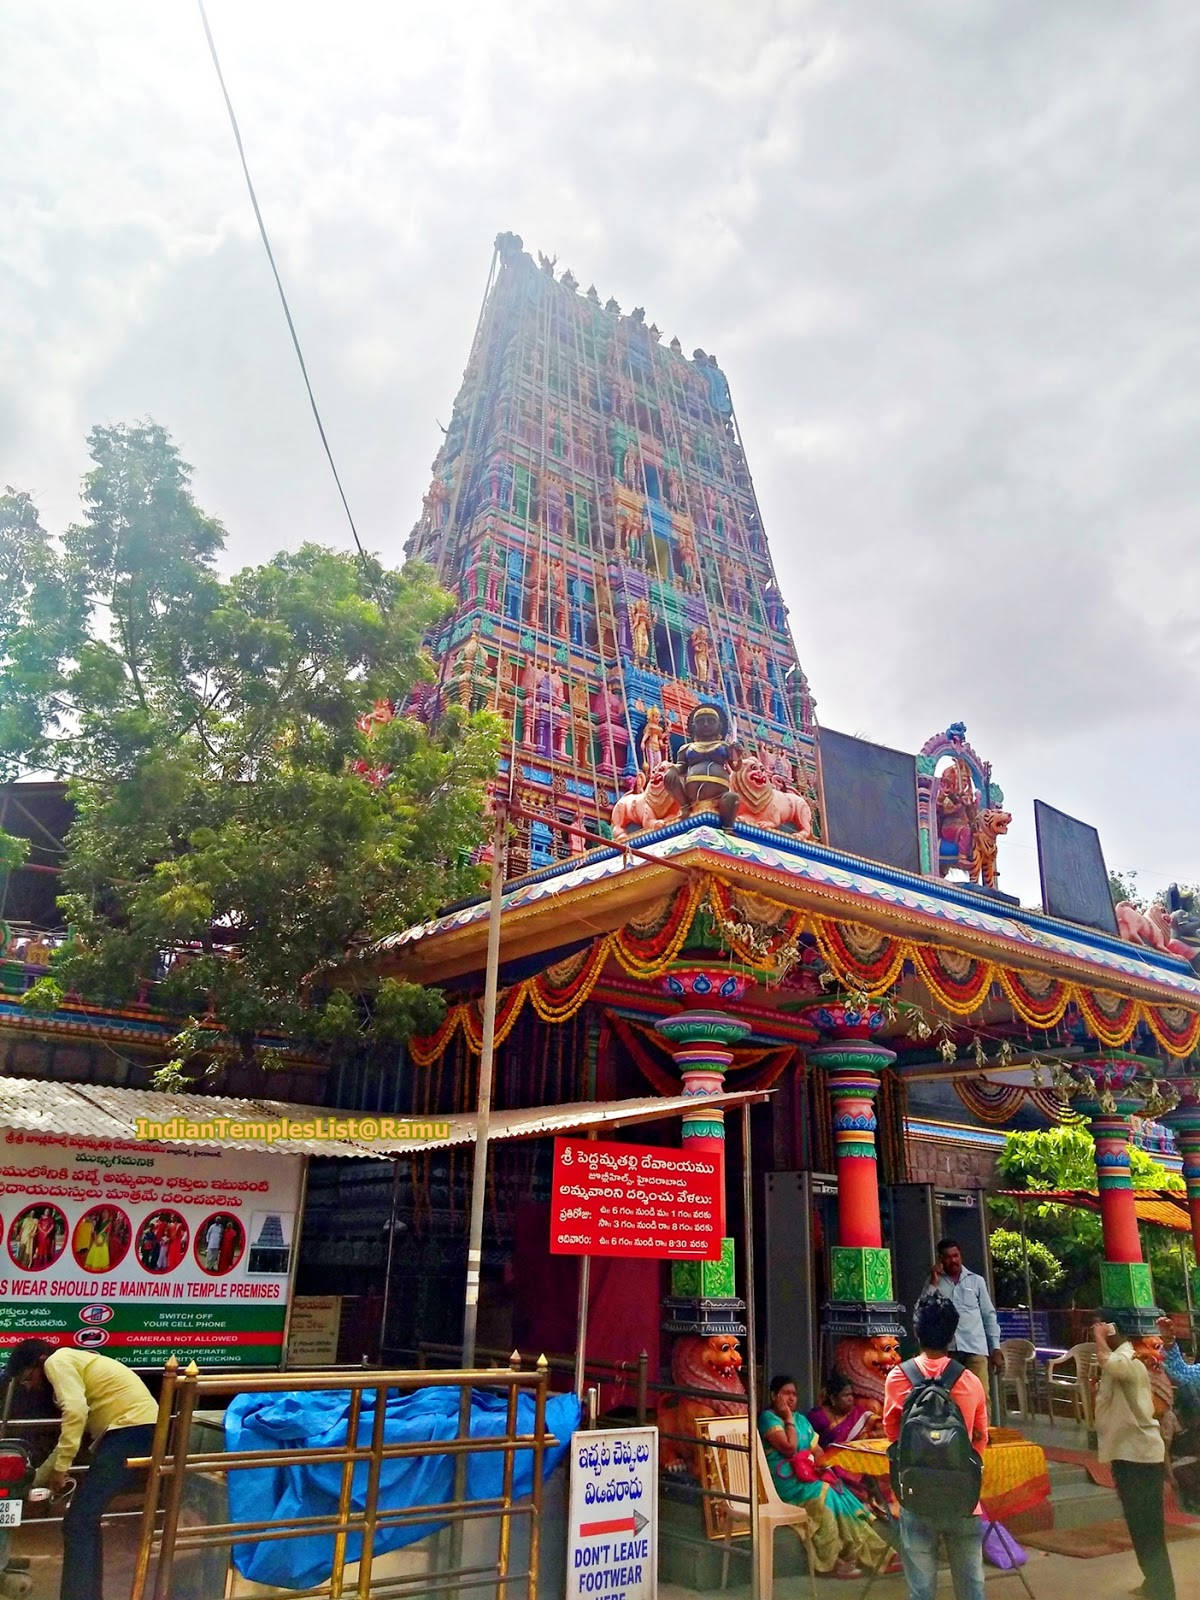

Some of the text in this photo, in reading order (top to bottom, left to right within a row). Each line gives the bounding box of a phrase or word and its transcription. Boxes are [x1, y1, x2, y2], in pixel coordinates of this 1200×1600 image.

[561, 1146, 715, 1174] శ్రీ పెద్దమ్మతల్లి దేవాలయము
[72, 1169, 100, 1186] వచ్చే
[103, 1173, 163, 1189] అమ్మవారి
[166, 1178, 208, 1192] భక్తులు
[106, 1189, 158, 1204] మాత్రమే
[560, 1185, 624, 1201] అమ్మవారిని
[626, 1189, 674, 1205] దర్శించు
[612, 1206, 619, 1215] 6
[635, 1207, 656, 1216] నుండి
[693, 1211, 712, 1219] వరకు
[613, 1219, 619, 1228] 3
[636, 1220, 657, 1229] నుండి
[672, 1223, 678, 1231] 8
[694, 1223, 713, 1232] వరకు
[611, 1237, 617, 1245] 6
[634, 1237, 654, 1247] నుండి
[689, 1239, 709, 1249] వరకు
[11, 1280, 47, 1296] WEAR
[50, 1281, 98, 1297] SHOULD
[101, 1282, 117, 1297] BE
[119, 1282, 170, 1297] MAINTAIN
[172, 1283, 184, 1298] IN
[187, 1282, 227, 1298] TEMPLE
[229, 1284, 280, 1299] PREMISES
[579, 1442, 610, 1476] ఇచ్చట
[575, 1539, 648, 1568] DON'T LEAVE
[579, 1564, 643, 1593] FOOTWEAR
